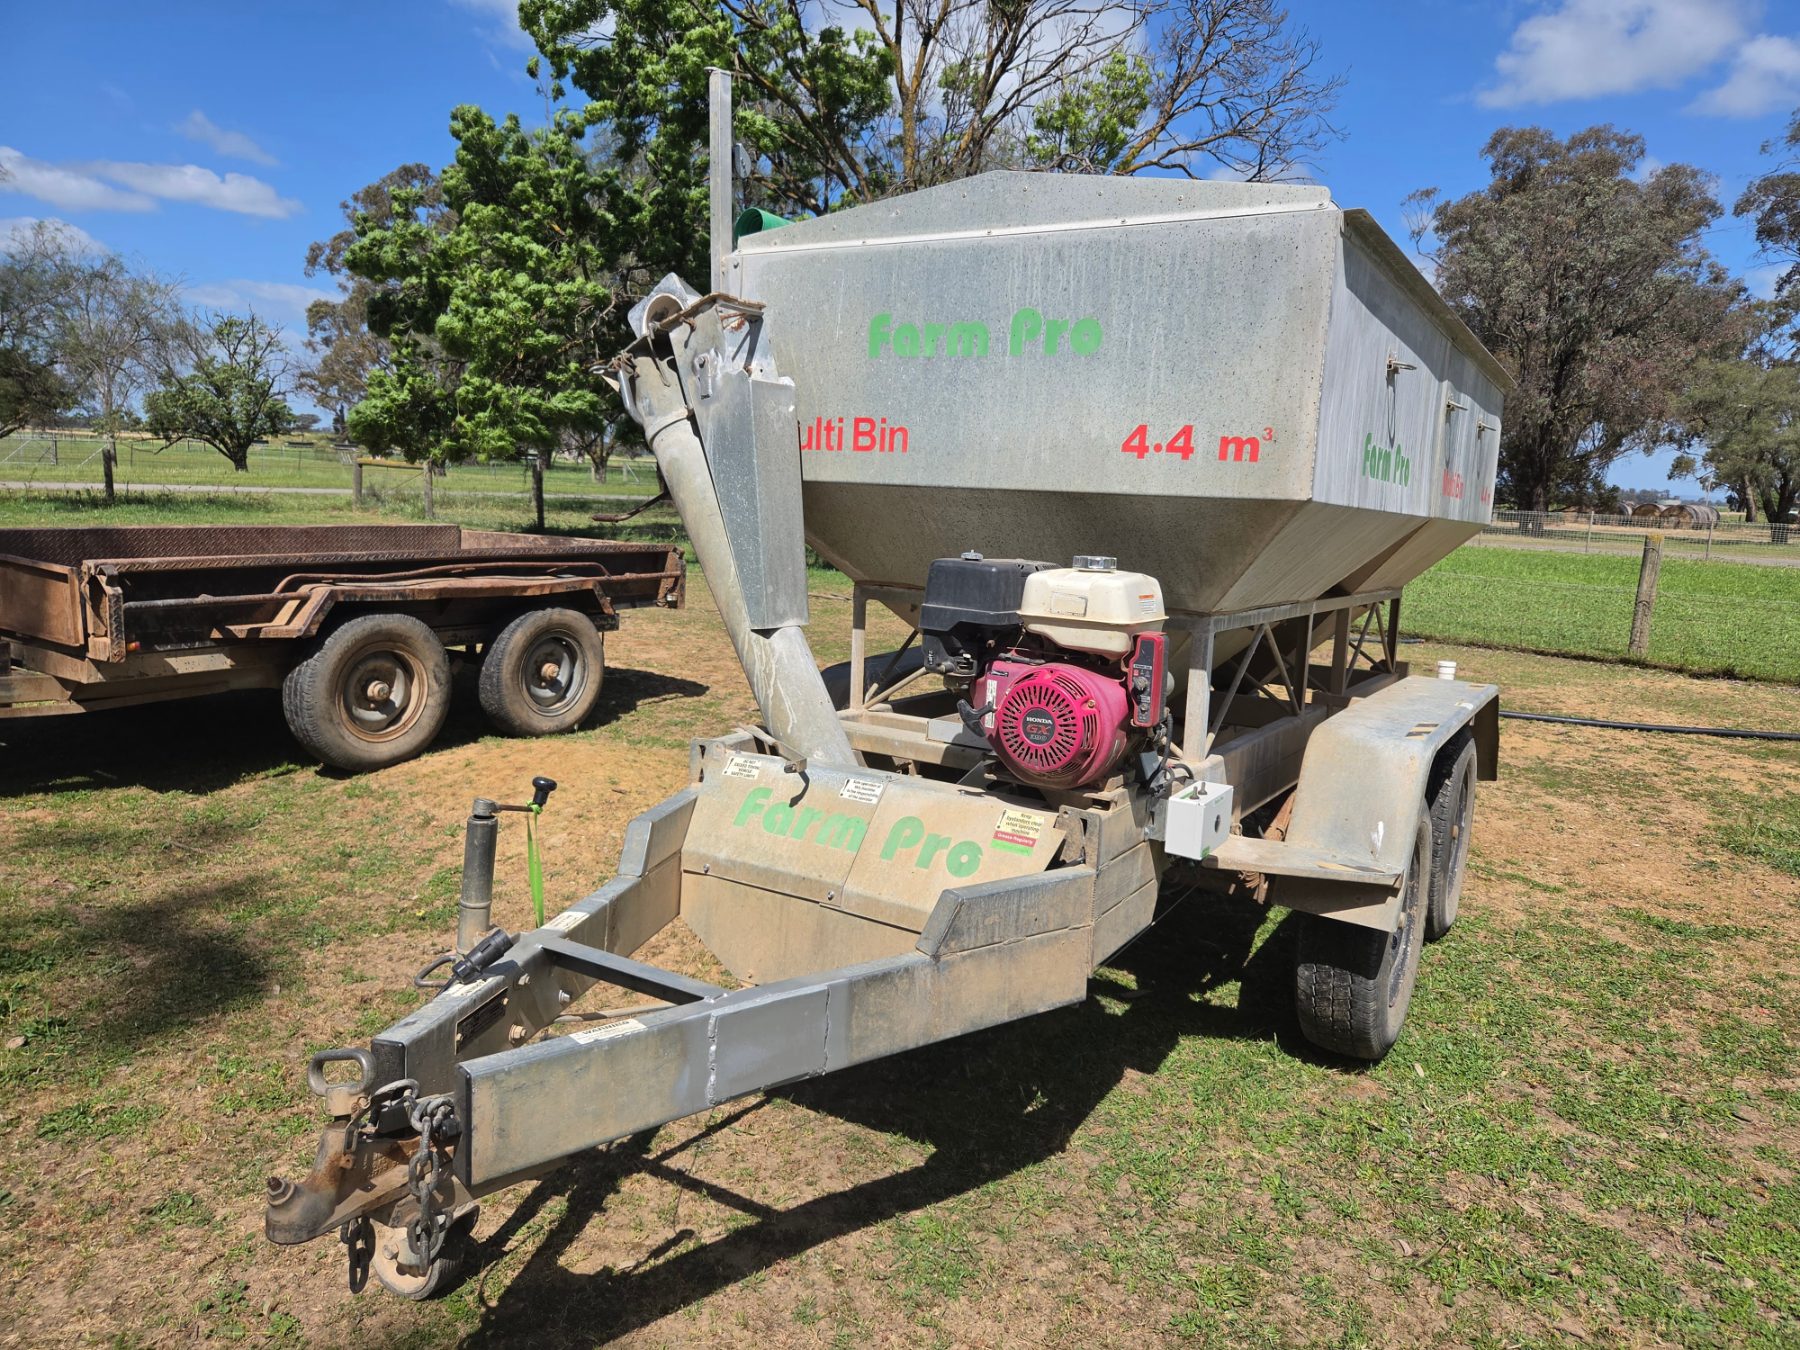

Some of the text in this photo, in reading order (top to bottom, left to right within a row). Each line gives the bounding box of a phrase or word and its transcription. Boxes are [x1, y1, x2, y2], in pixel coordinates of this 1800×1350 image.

[866, 307, 1104, 359] Farm Pro
[800, 416, 910, 454] ulti Bin
[1120, 423, 1195, 461] 4.4
[1362, 432, 1410, 487] Farm Pro
[1026, 716, 1053, 725] HONDA
[1026, 724, 1051, 735] GX
[733, 787, 984, 878] Farm Pro
